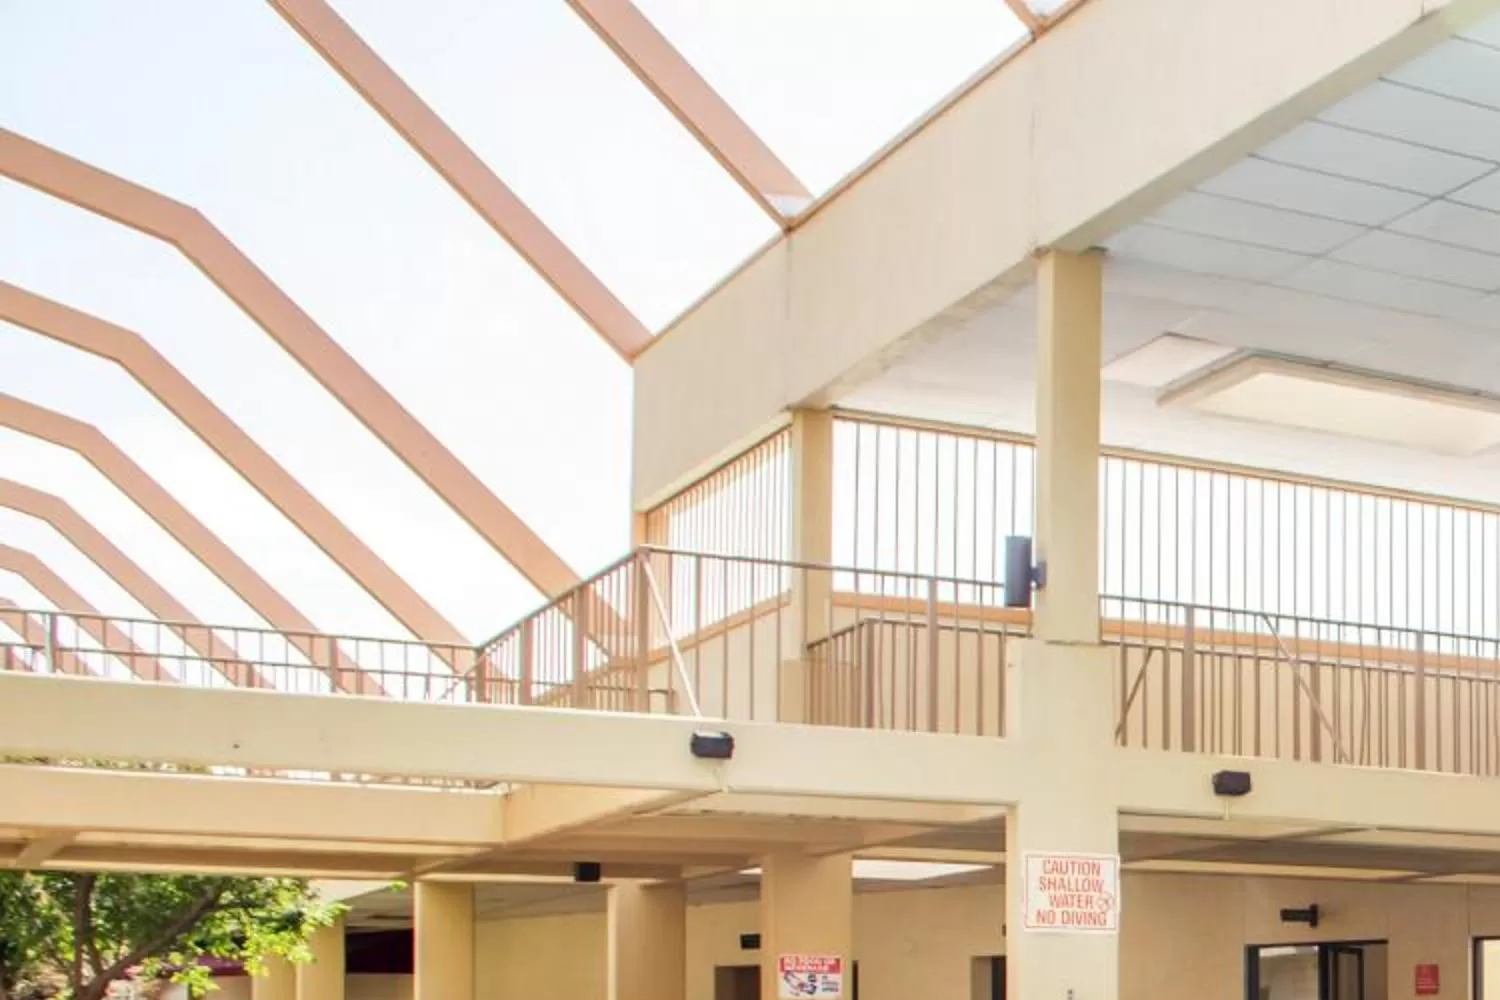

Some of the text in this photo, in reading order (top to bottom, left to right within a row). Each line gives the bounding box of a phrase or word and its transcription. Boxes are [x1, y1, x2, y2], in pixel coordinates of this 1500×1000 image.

[1043, 859, 1101, 875] CAUTION
[1039, 877, 1104, 893] SHALLOW
[1049, 894, 1093, 909] WATER
[1036, 910, 1107, 926] NO DIVING
